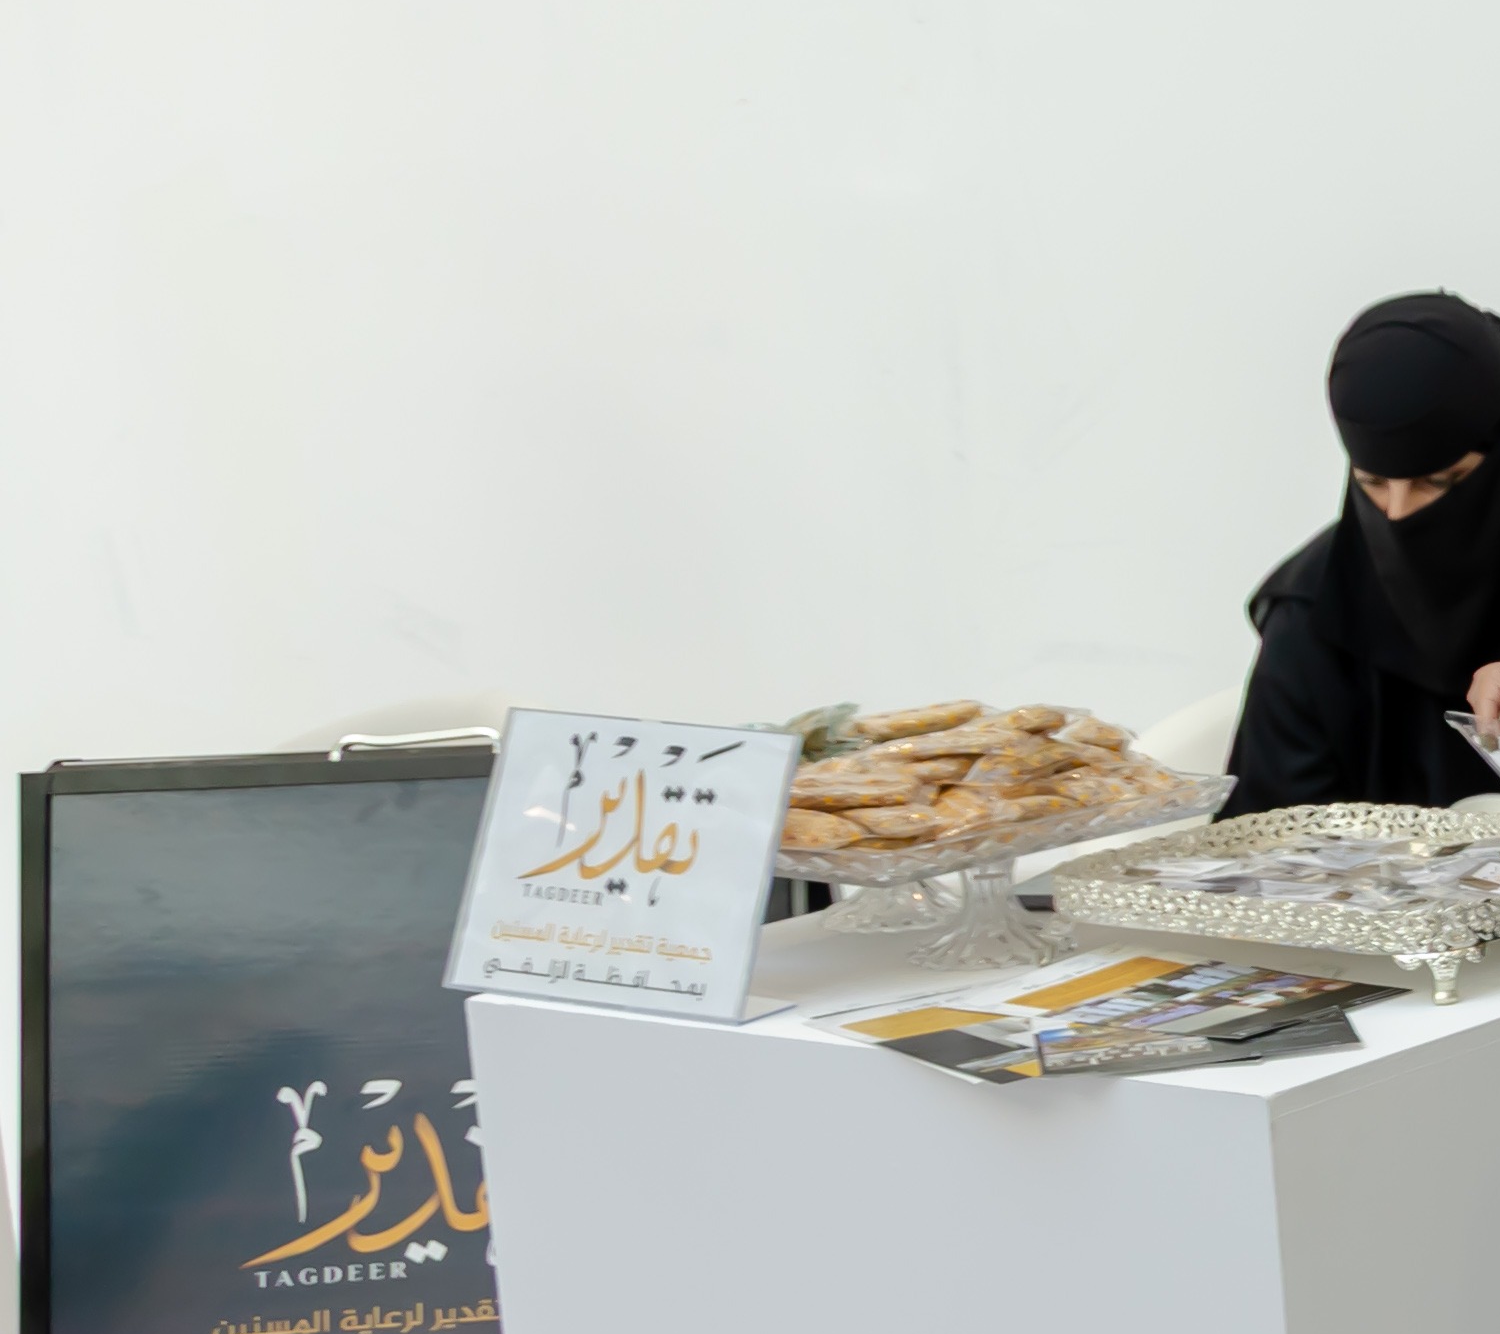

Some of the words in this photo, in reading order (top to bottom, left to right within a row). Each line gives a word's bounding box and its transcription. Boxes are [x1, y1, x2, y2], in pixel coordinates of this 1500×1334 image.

[521, 883, 604, 907] TAGDEER
[656, 938, 713, 965] جمعية
[254, 1261, 408, 1288] TAGDEER
[340, 1301, 424, 1334] لرعاية
